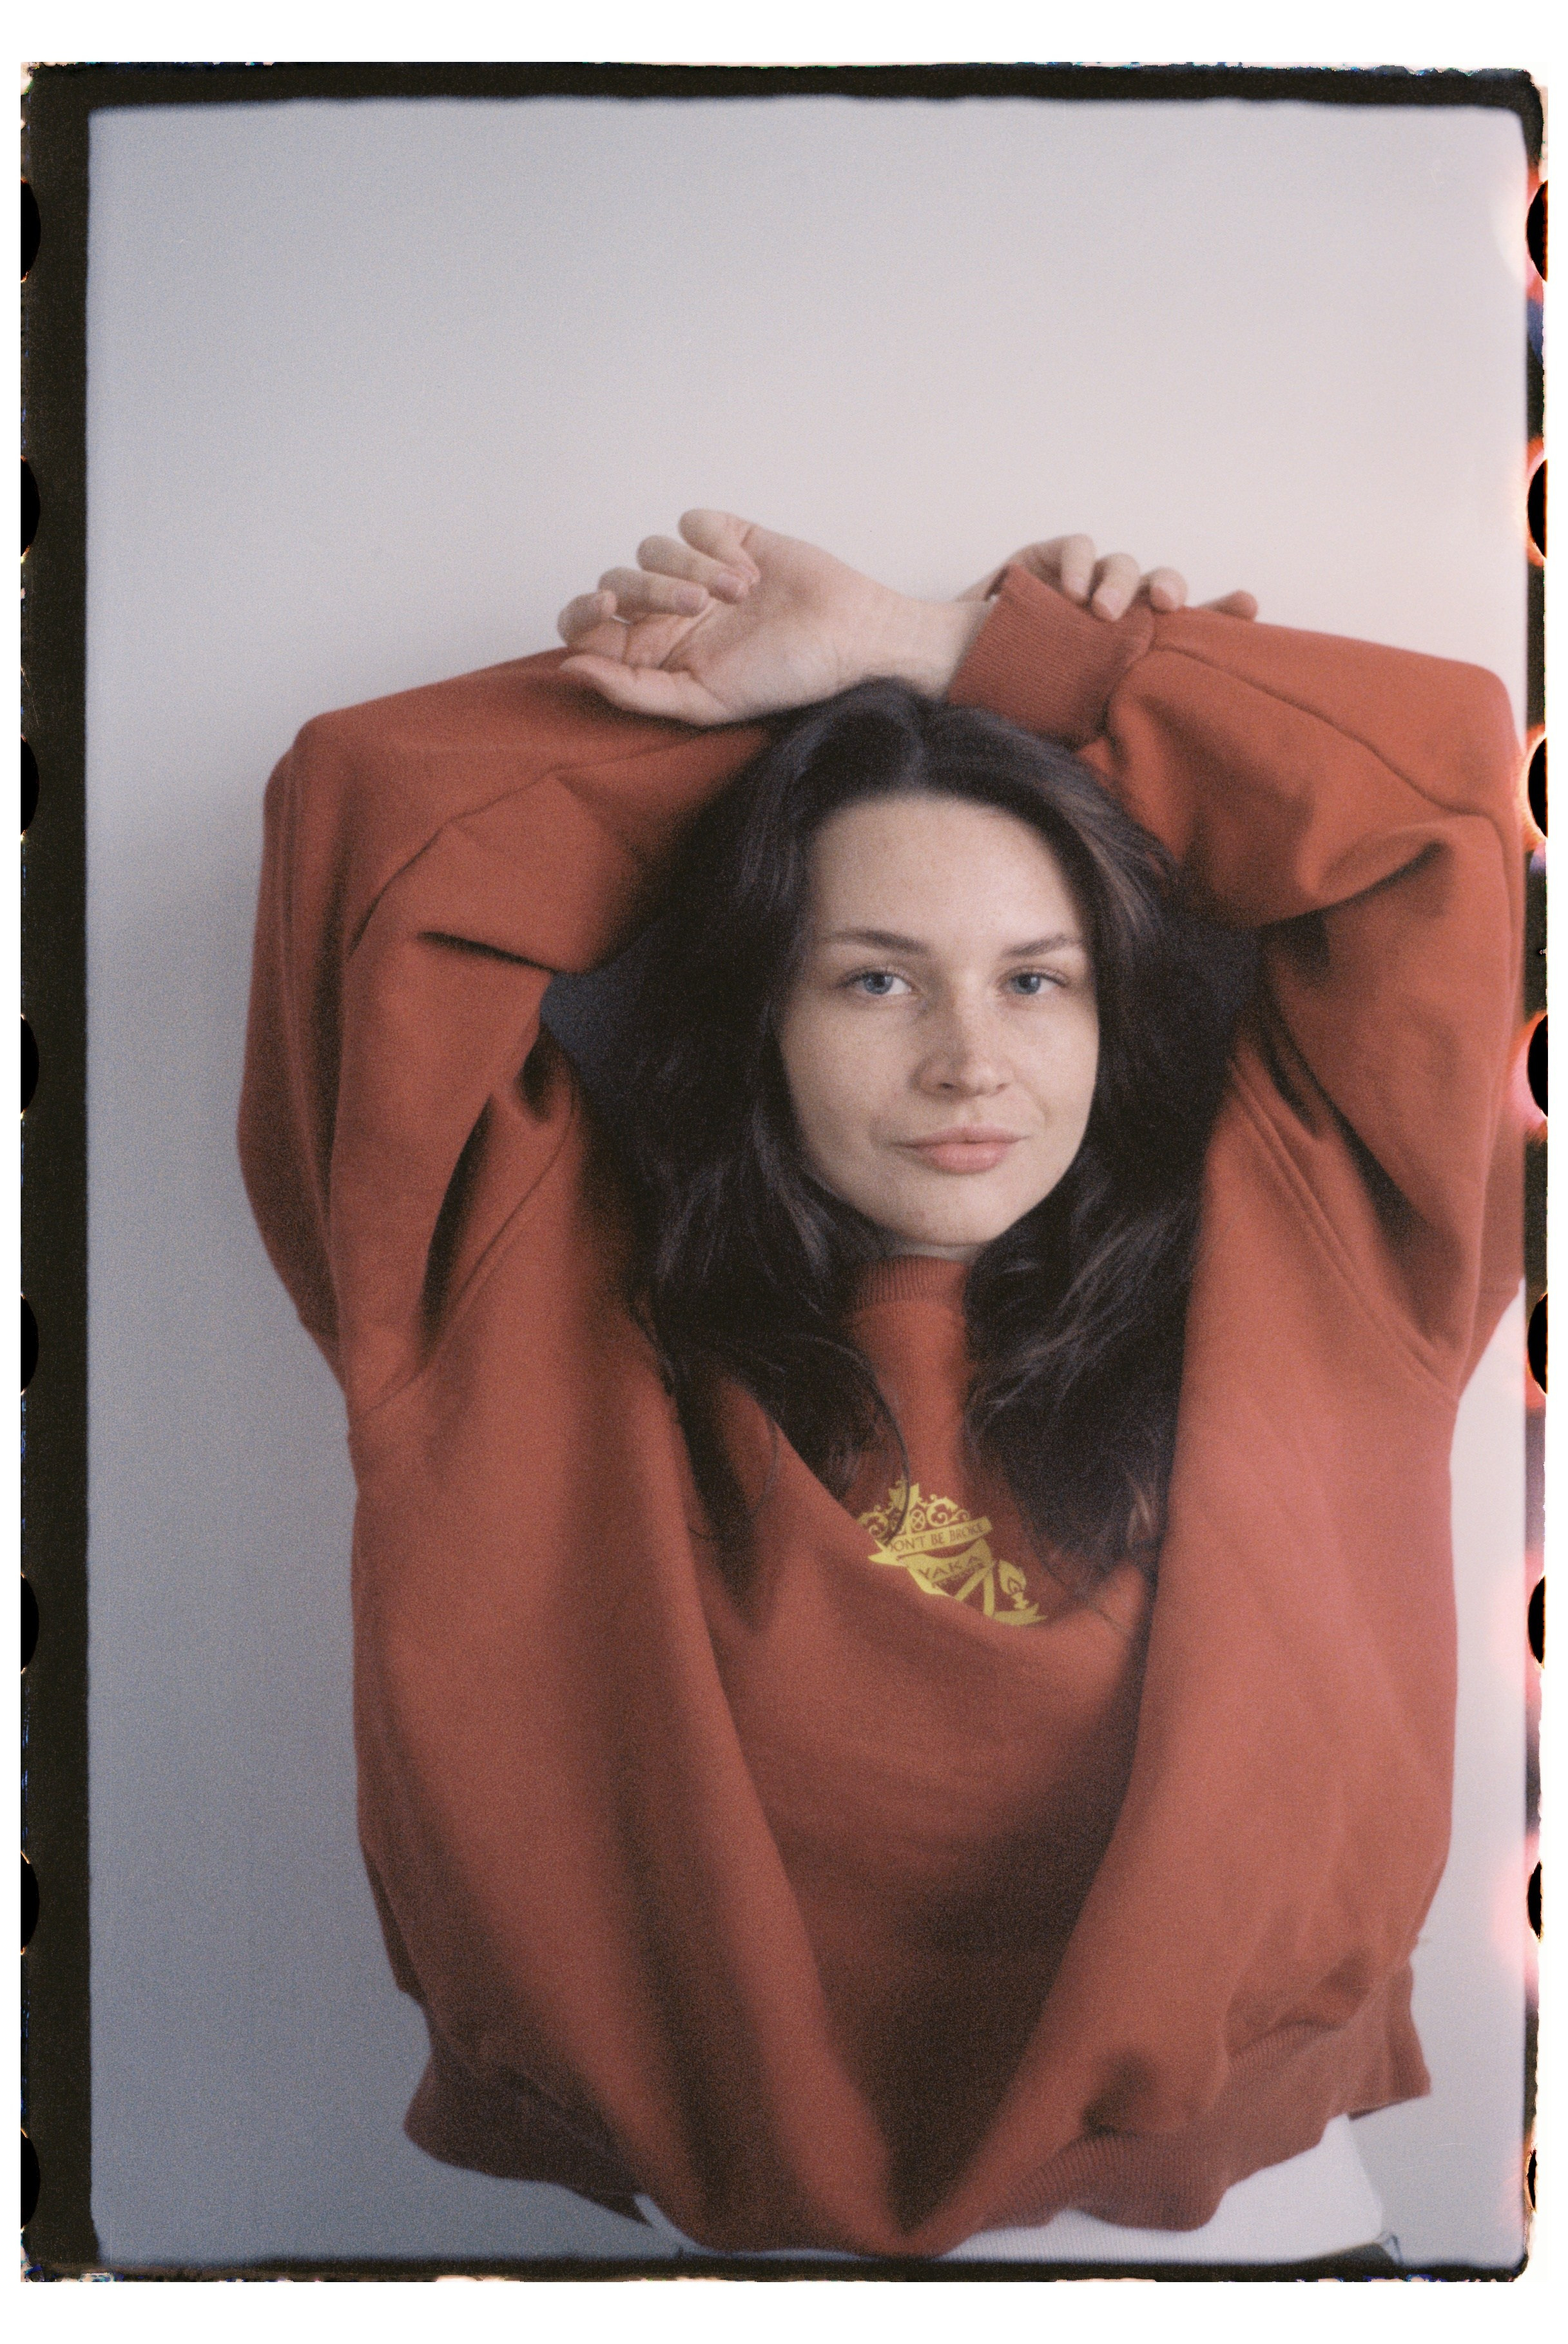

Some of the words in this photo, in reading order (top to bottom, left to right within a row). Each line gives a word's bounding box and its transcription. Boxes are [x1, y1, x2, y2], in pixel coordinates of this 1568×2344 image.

[931, 1533, 944, 1545] BE
[949, 1523, 983, 1541] BROKE
[918, 1555, 983, 1579] YAKA
